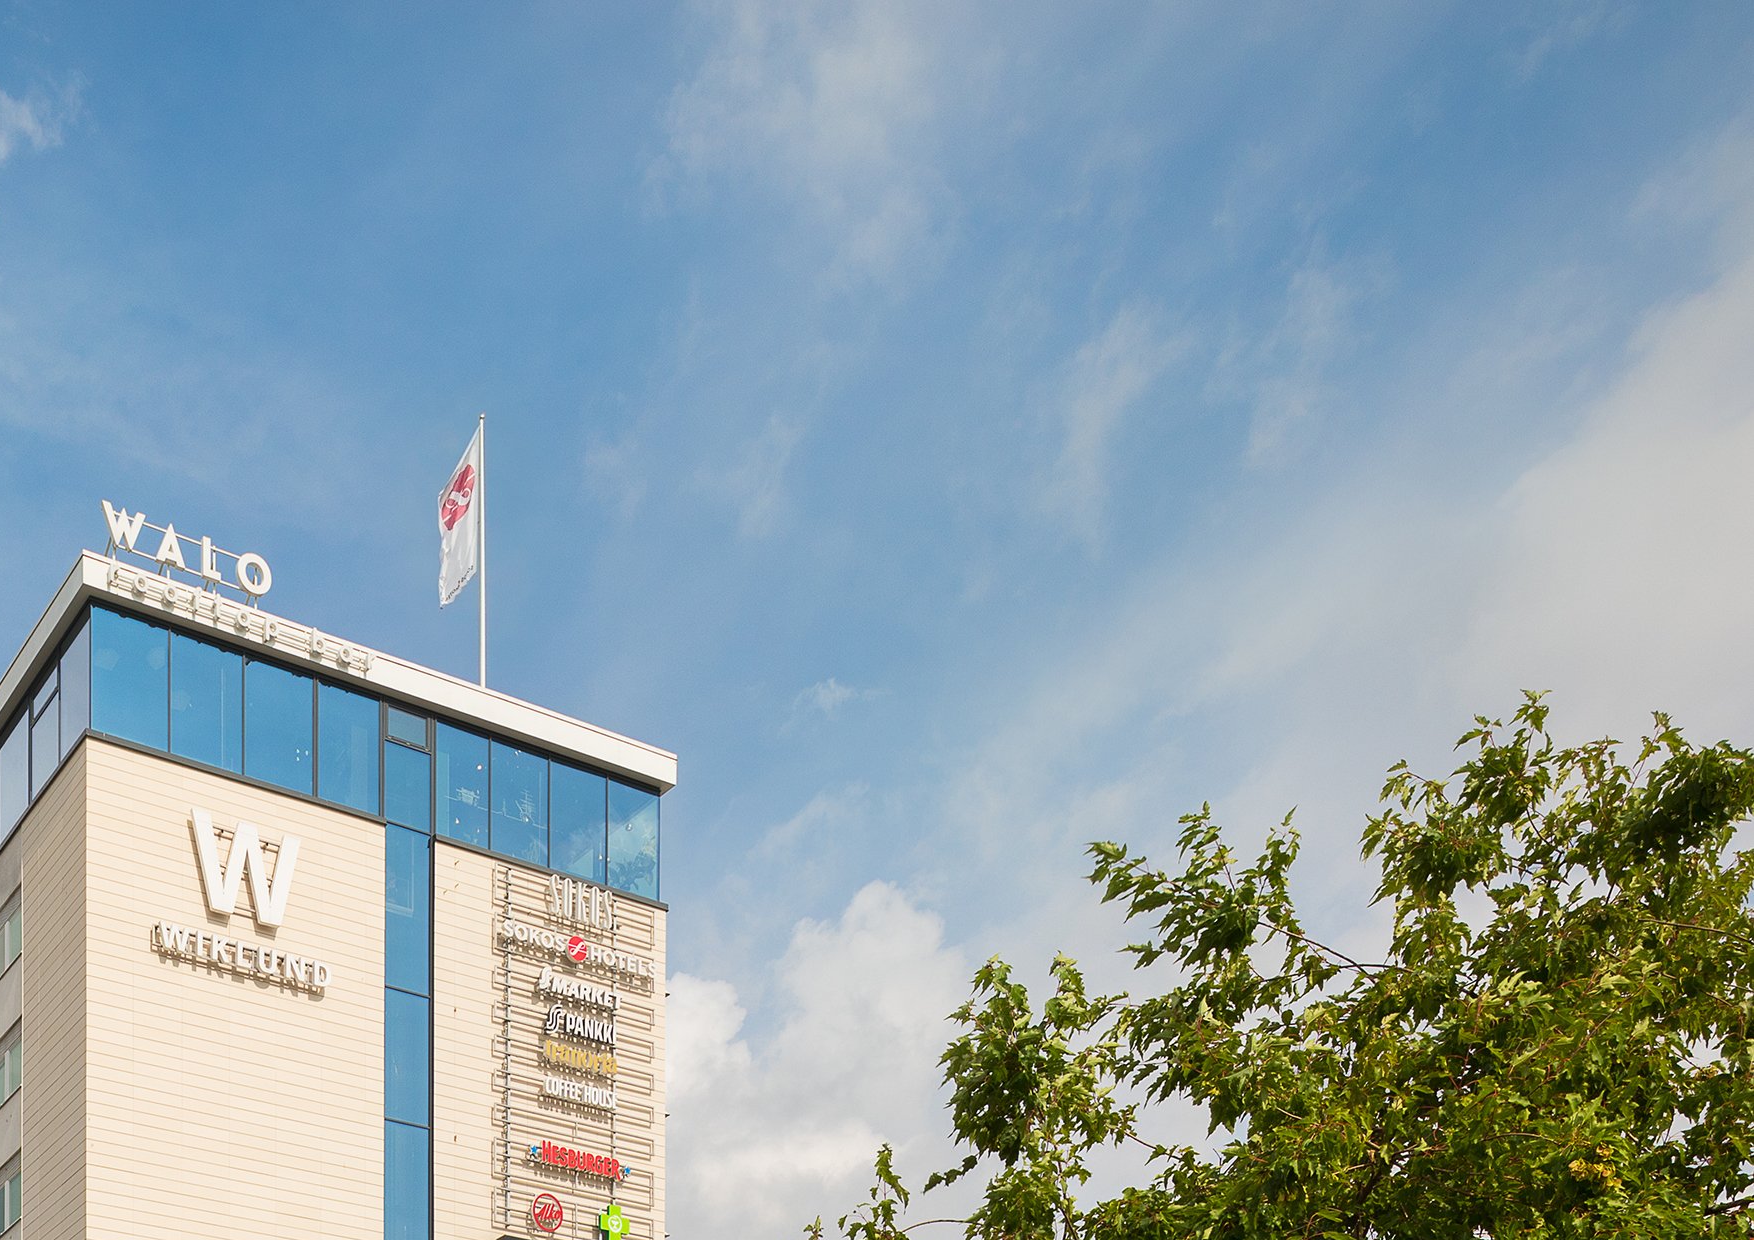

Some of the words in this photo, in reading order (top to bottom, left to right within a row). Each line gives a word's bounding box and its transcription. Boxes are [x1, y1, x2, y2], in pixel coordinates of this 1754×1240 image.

[101, 499, 273, 597] WALO
[311, 627, 375, 671] bar
[190, 808, 301, 927] W
[549, 874, 613, 930] SOKOS
[157, 919, 332, 988] WIKLUND
[502, 918, 566, 952] SOKOS
[589, 948, 656, 978] HOTELS
[551, 976, 622, 1010] MARKET
[565, 1013, 616, 1044] PANKKI
[545, 1039, 618, 1074] trattoria
[545, 1076, 581, 1102] COFFEE
[583, 1085, 618, 1110] HOUSE
[541, 1139, 621, 1180] HESBURGER
[535, 1203, 561, 1220] Alko
